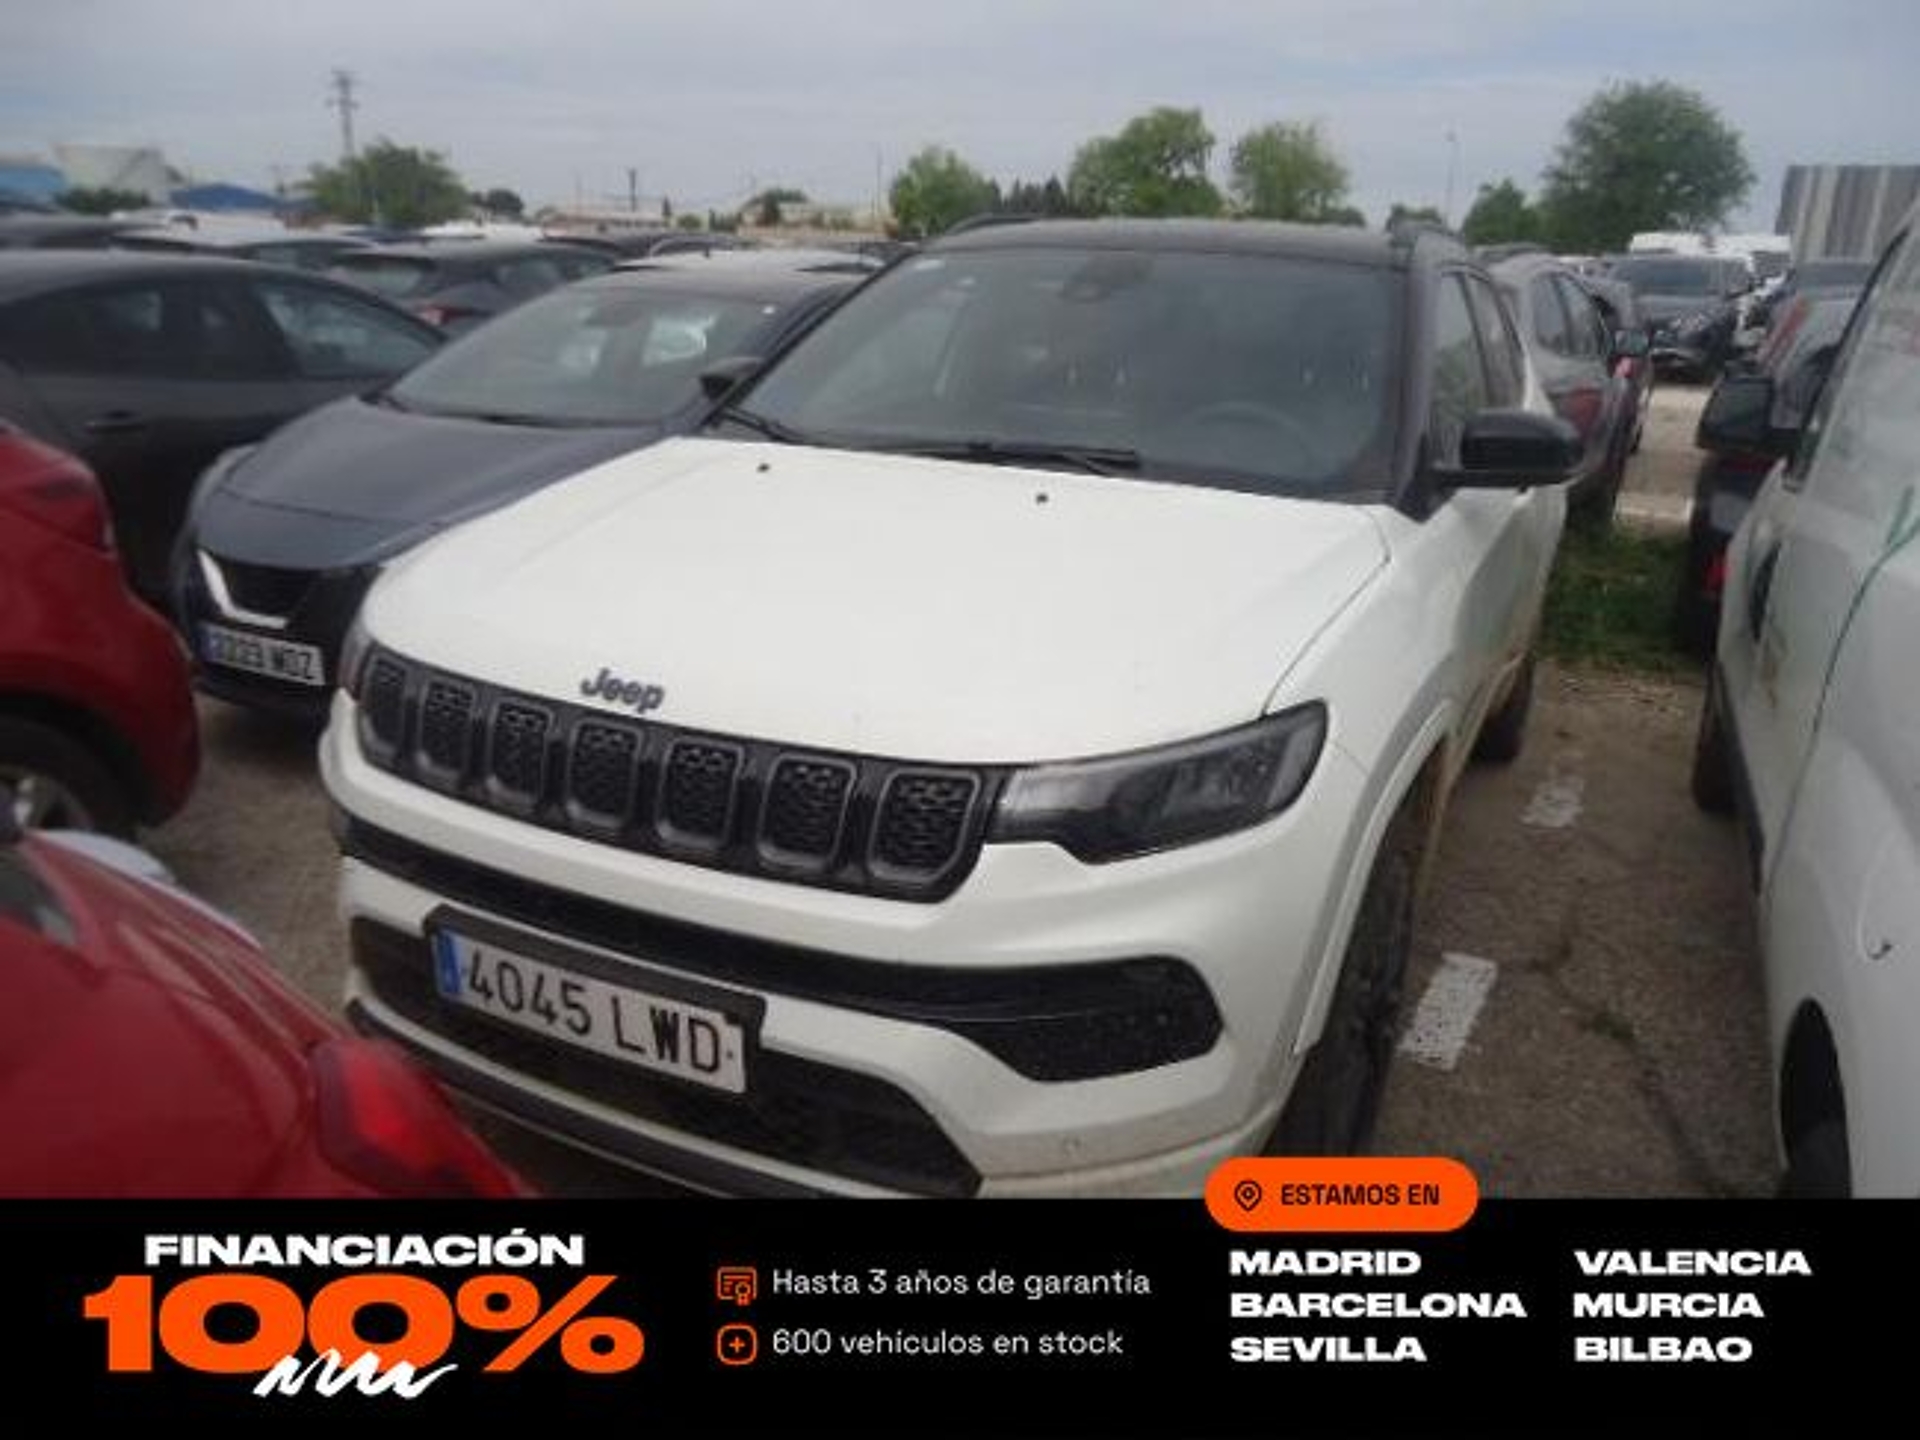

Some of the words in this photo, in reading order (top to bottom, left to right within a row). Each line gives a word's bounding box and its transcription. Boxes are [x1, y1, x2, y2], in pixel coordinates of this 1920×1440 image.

[580, 667, 665, 715] Jeep
[469, 951, 592, 1036] 4045
[611, 995, 720, 1074] LWD
